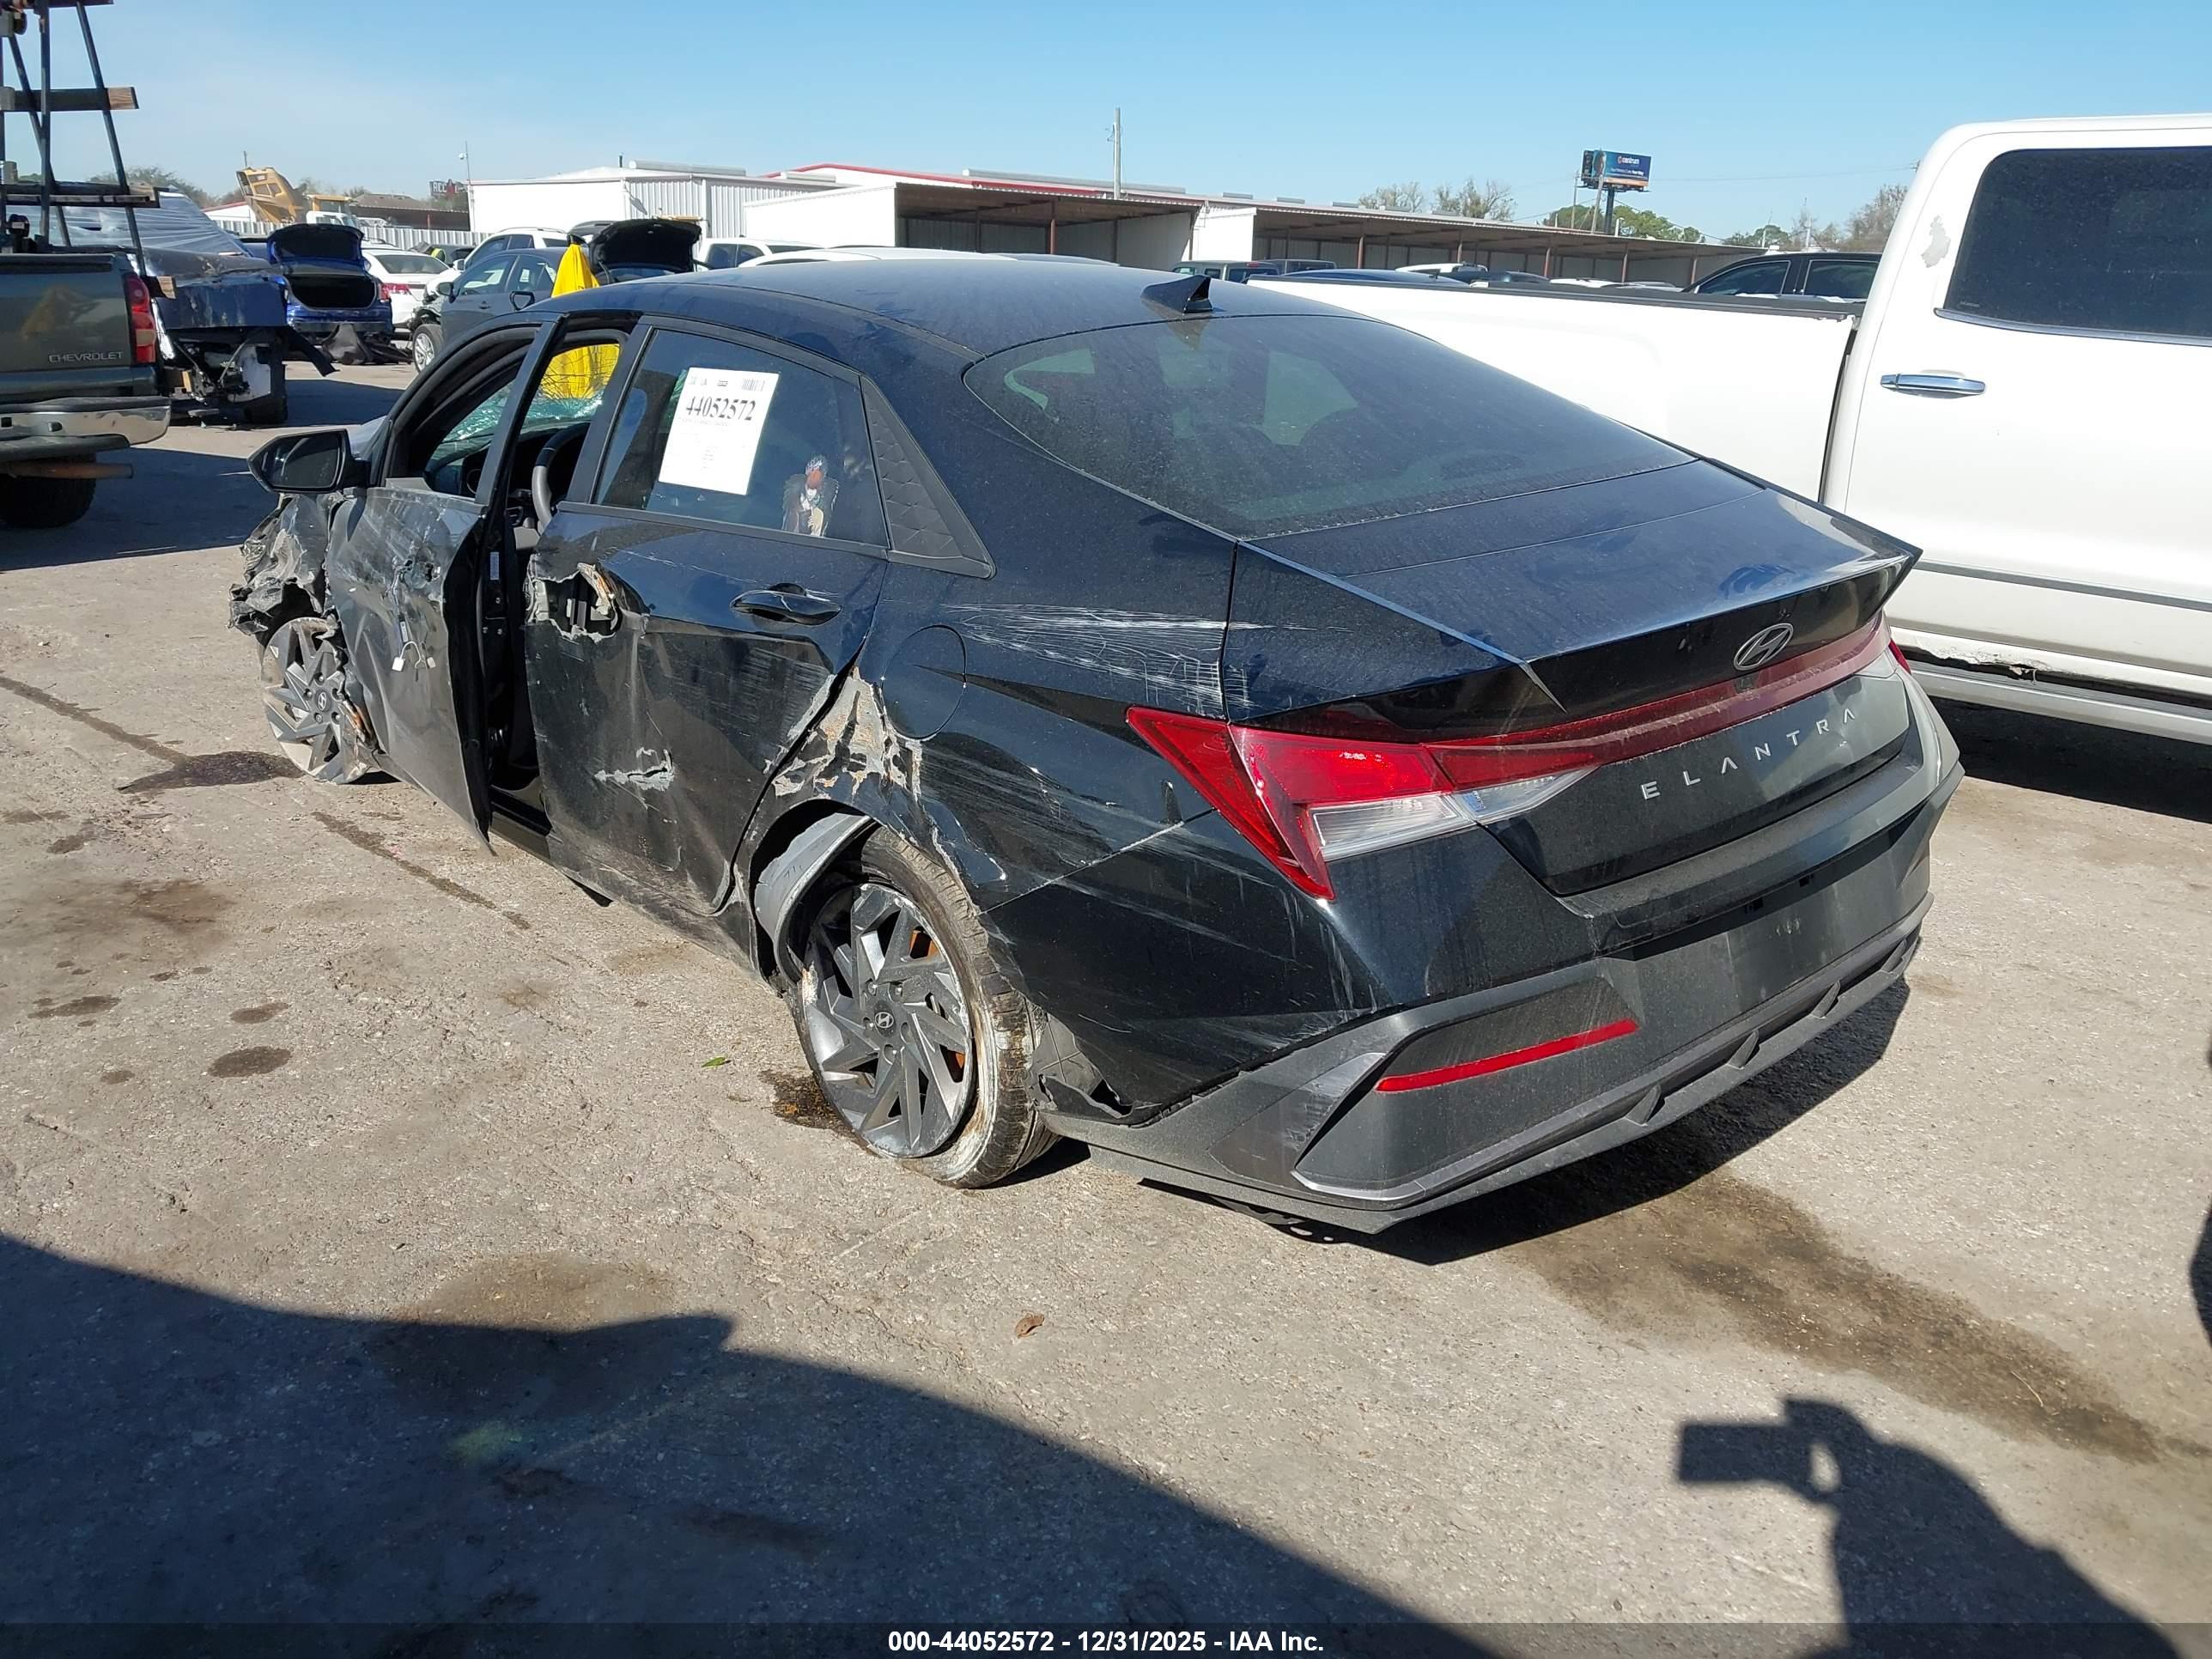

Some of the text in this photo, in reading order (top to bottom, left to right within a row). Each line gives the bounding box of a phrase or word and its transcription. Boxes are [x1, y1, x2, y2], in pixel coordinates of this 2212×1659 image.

[48, 351, 124, 363] CHEVROLET
[686, 396, 757, 421] 44052572
[1641, 708, 1855, 799] ELANTRA
